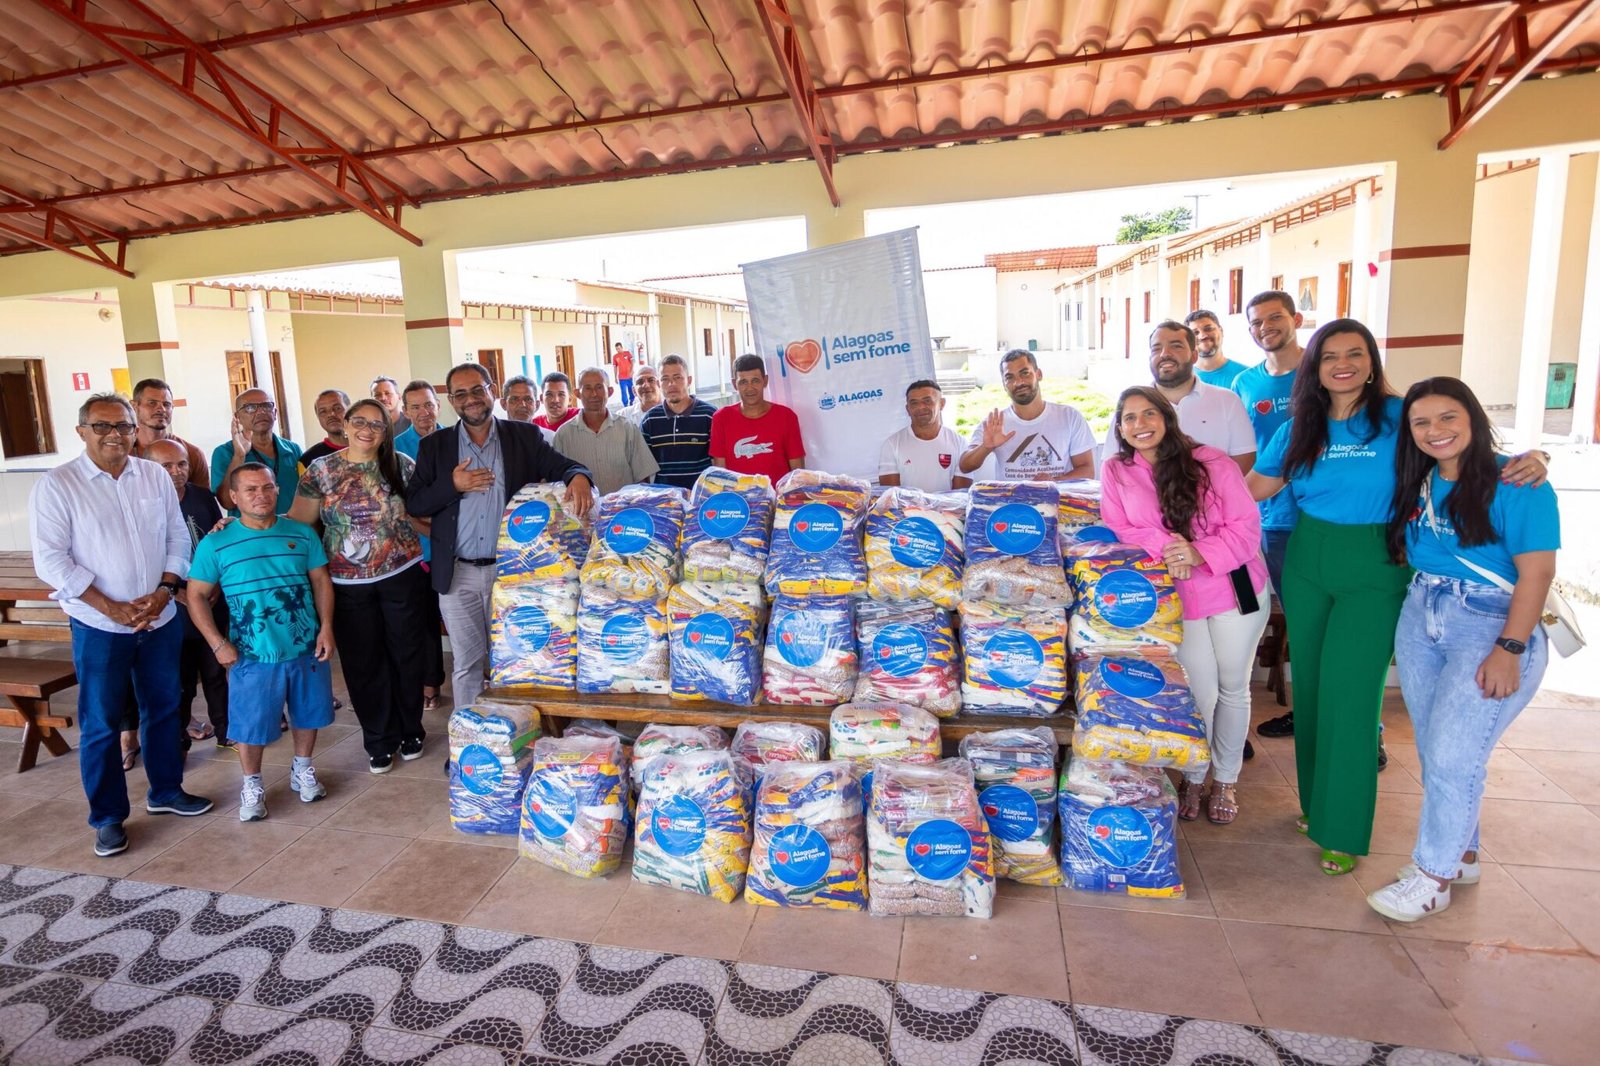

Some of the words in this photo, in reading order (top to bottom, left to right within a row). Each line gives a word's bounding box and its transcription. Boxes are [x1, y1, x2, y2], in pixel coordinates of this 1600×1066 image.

[831, 330, 894, 350] Alagoas
[833, 350, 866, 364] sem
[869, 342, 910, 358] fome
[838, 389, 883, 402] ALAGOAS
[1329, 444, 1369, 452] Alagoas
[793, 848, 818, 857] Alagoas
[808, 851, 826, 860] fome
